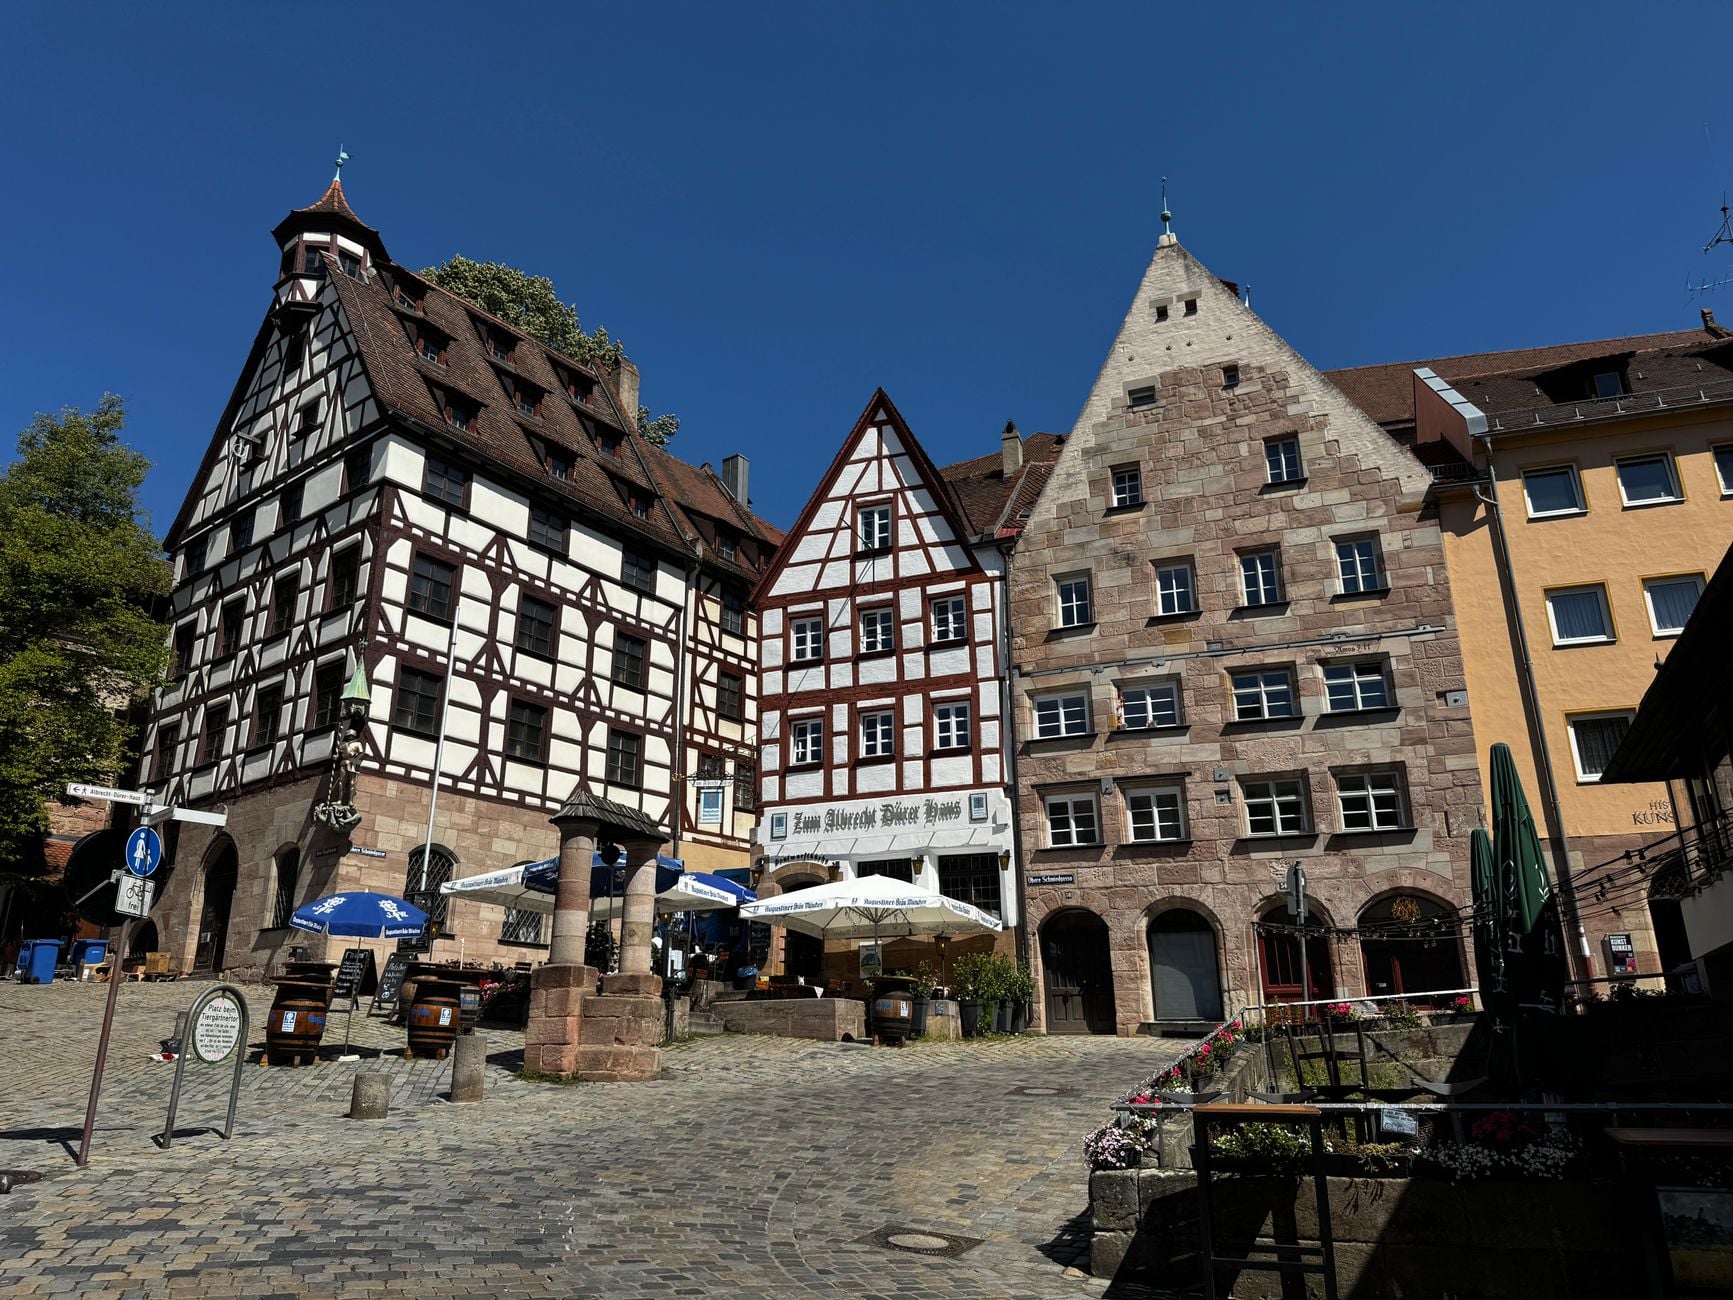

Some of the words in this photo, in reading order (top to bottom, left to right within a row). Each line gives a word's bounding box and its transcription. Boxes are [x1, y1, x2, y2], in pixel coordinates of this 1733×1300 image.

[1334, 645, 1356, 654] Amos
[1649, 800, 1670, 810] HIS
[792, 812, 821, 834] Zum
[823, 807, 877, 833] Albrecht
[880, 802, 920, 827] Dürer
[924, 798, 962, 827] Haus
[1632, 811, 1675, 825] KUNS
[128, 901, 139, 911] frei
[208, 1004, 222, 1012] Platz
